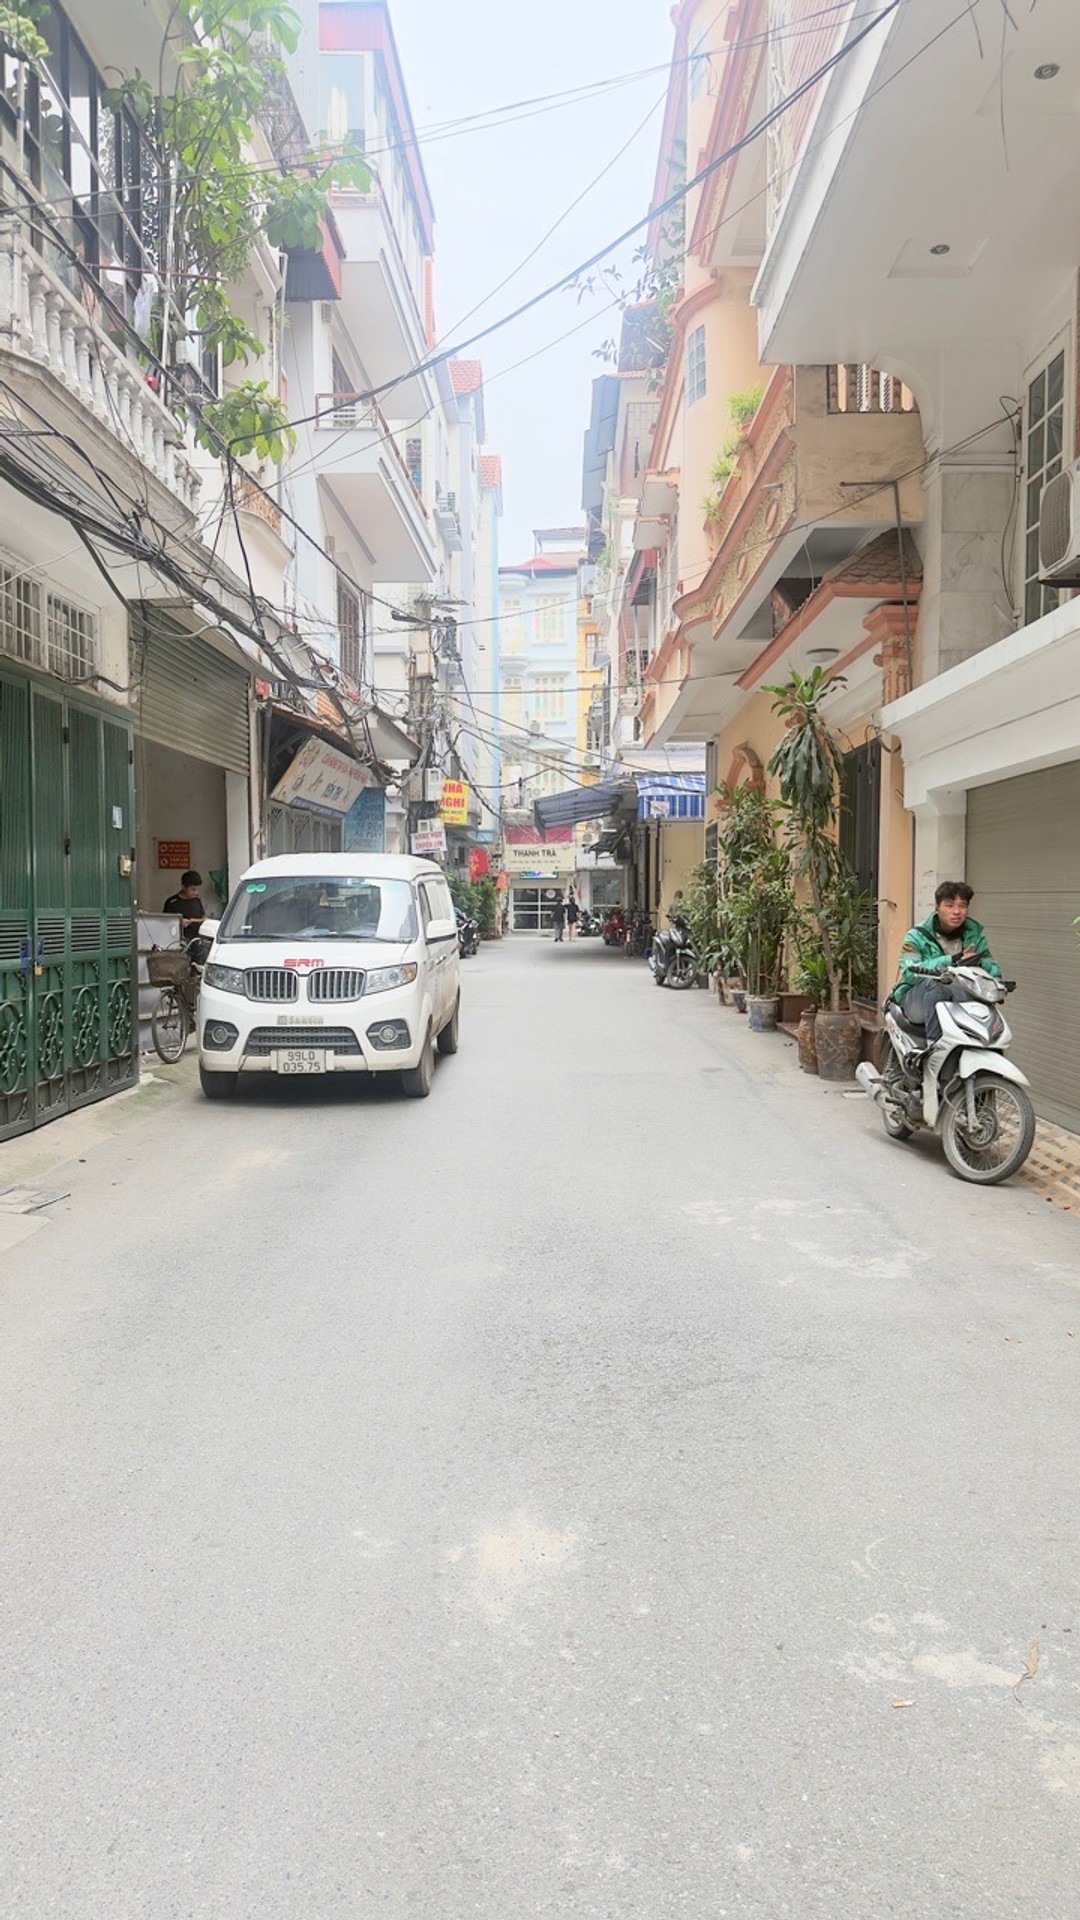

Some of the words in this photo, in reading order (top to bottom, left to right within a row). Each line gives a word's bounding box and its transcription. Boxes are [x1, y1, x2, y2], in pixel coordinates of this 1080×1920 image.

[514, 849, 540, 857] THANH
[284, 958, 325, 968] SRM
[283, 1062, 321, 1073] 035.75
